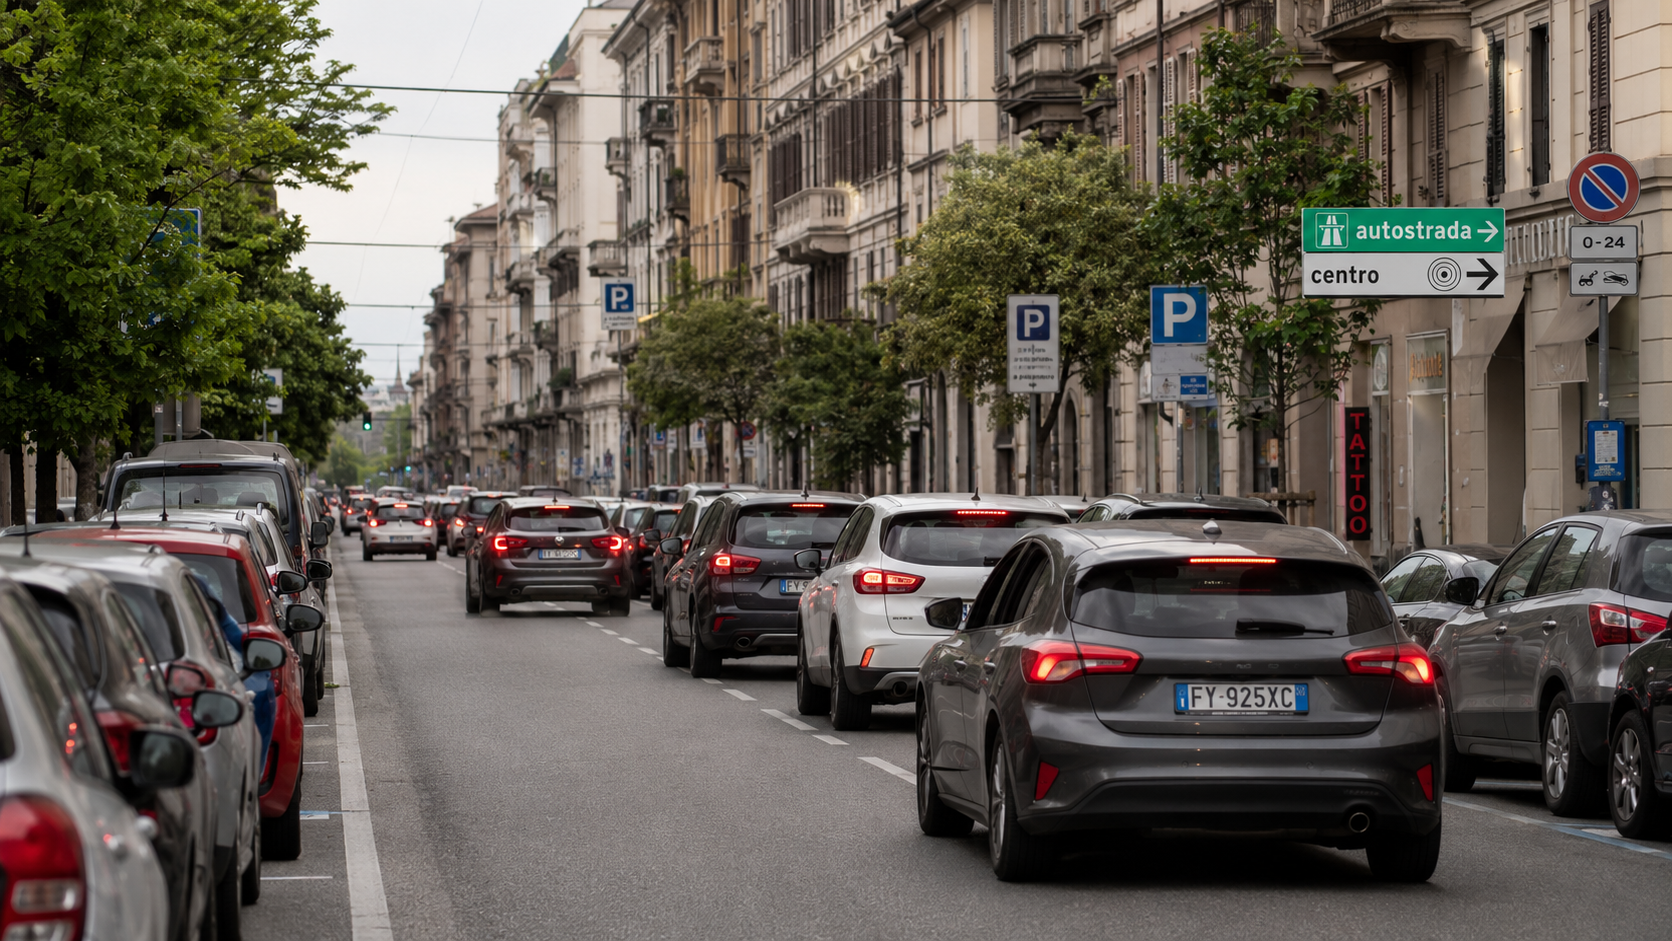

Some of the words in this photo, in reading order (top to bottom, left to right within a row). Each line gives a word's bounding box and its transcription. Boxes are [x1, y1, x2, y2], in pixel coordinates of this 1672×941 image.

[1356, 220, 1472, 240] autostrada
[1582, 236, 1626, 249] 0-24
[1311, 265, 1380, 284] centro
[611, 287, 629, 310] P
[1024, 309, 1045, 337] P
[1164, 293, 1197, 337] P
[1349, 412, 1367, 534] TATTOO
